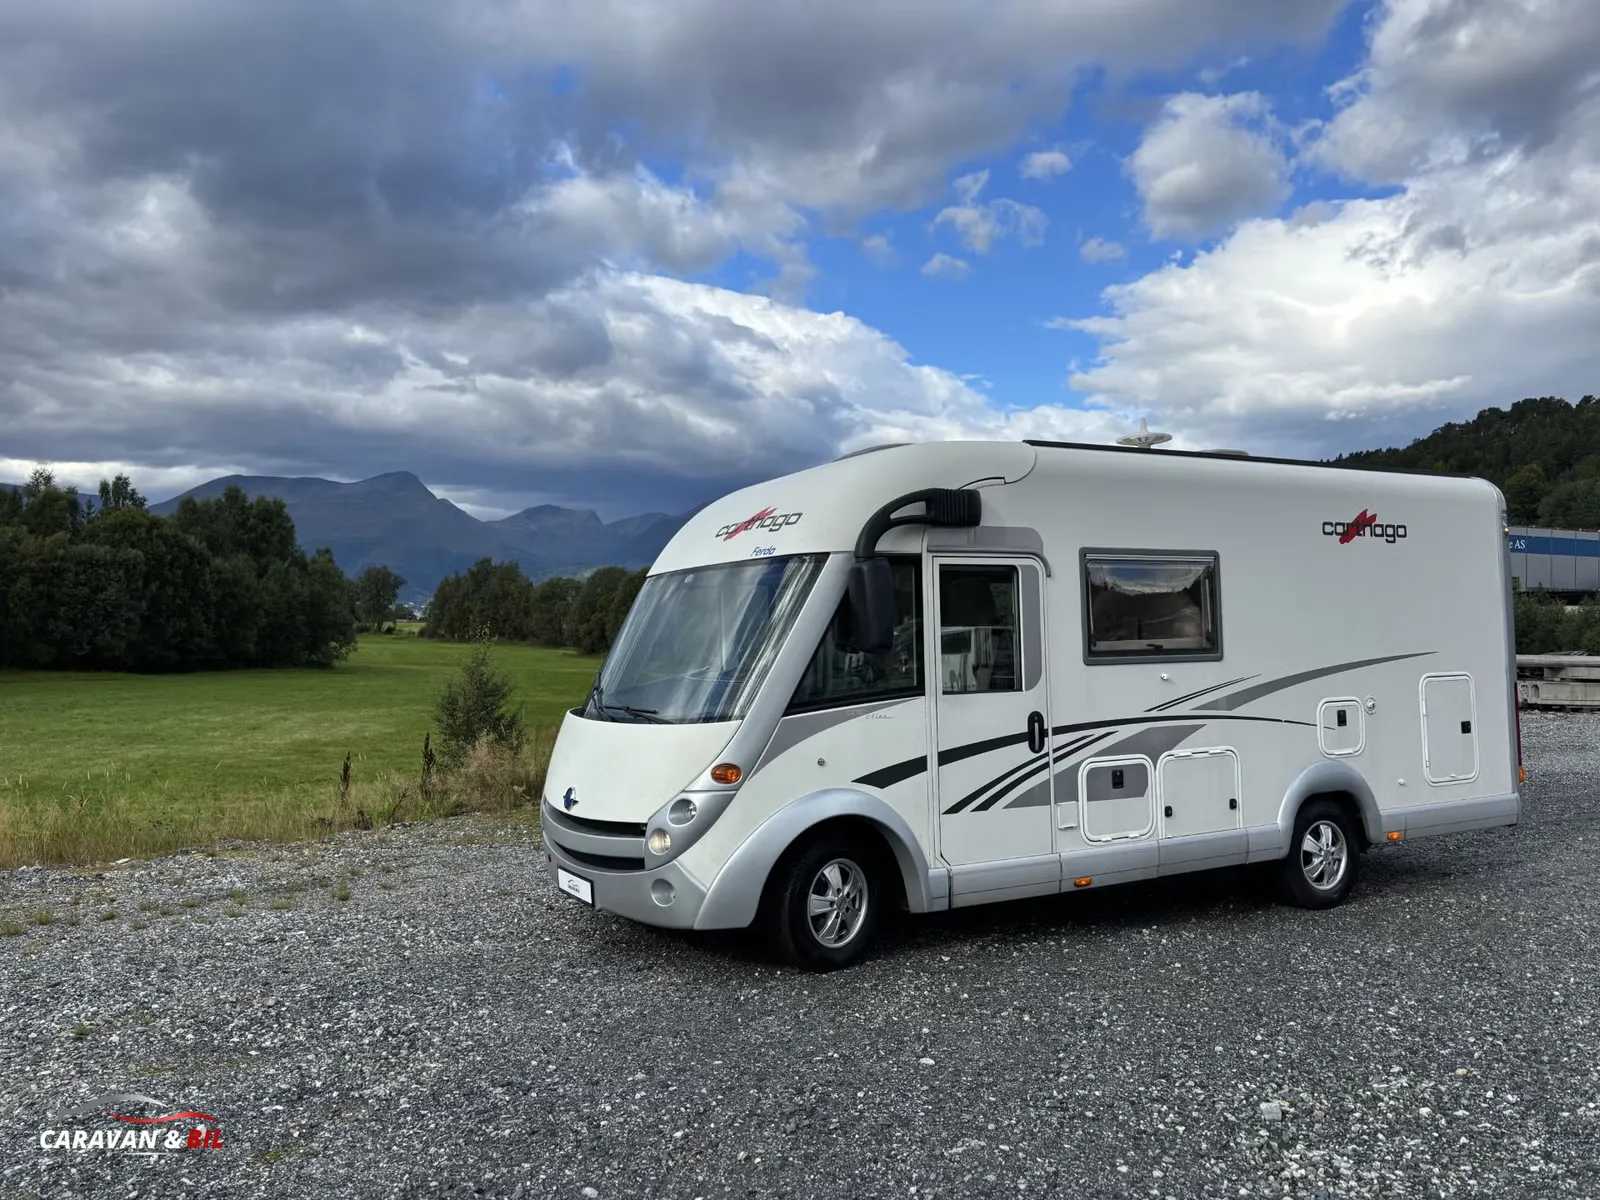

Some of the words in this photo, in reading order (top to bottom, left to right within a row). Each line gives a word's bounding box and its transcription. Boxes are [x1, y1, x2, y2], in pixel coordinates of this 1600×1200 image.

[715, 512, 803, 537] carthago
[1322, 521, 1407, 543] carthago
[750, 545, 776, 556] Ferda
[1514, 540, 1526, 549] AS
